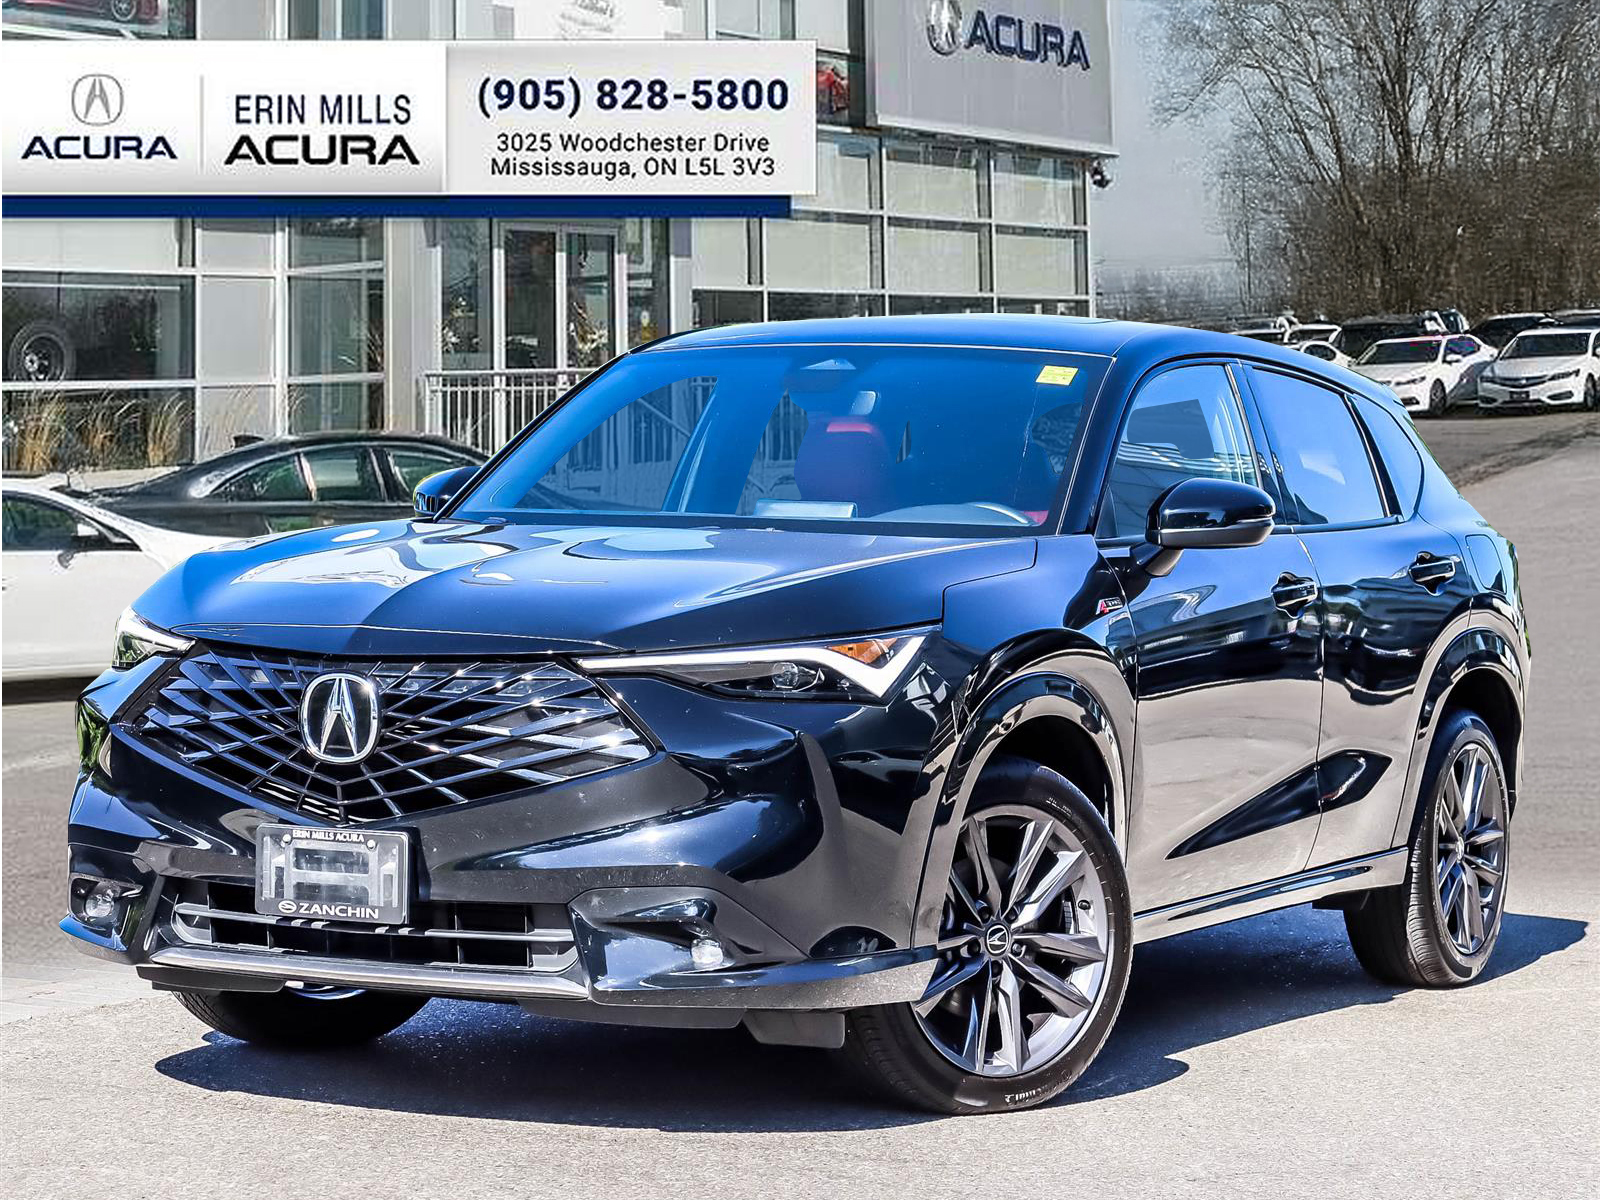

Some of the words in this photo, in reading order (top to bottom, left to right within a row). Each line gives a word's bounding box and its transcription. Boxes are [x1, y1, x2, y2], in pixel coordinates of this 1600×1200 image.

[964, 10, 1091, 71] ACURA
[311, 831, 334, 840] MILLS
[335, 833, 364, 842] ACURA
[299, 903, 379, 919] ZANCHIN
